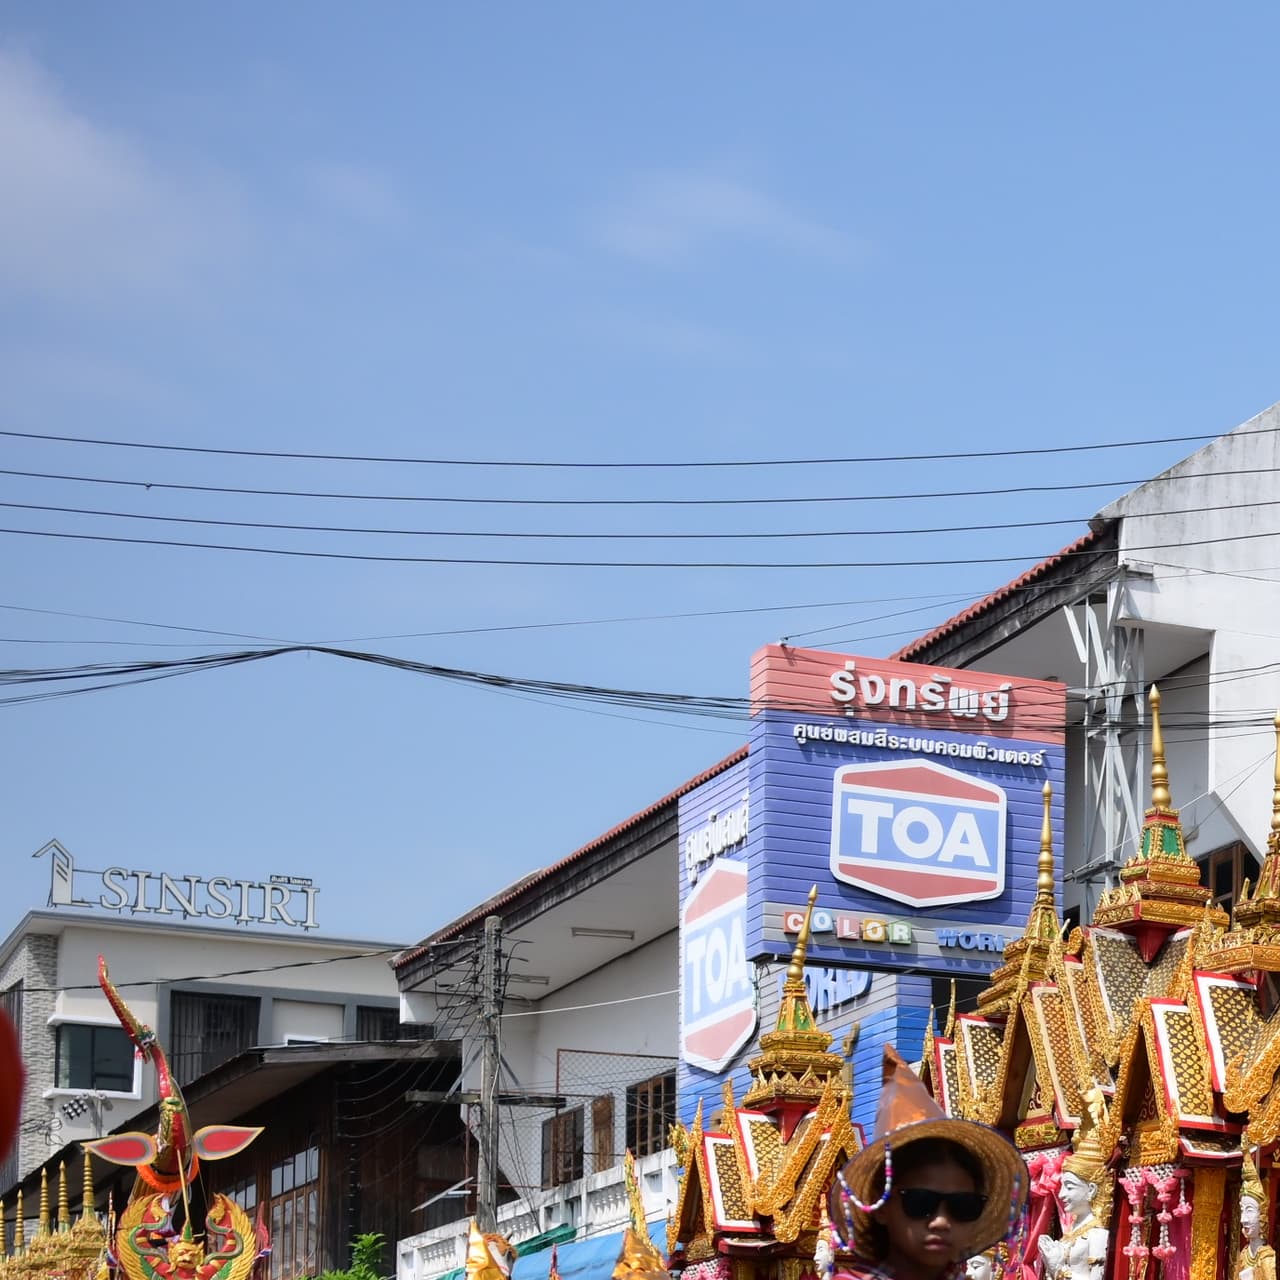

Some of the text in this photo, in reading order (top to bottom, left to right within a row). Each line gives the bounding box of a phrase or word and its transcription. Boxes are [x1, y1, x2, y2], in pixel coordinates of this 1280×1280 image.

[829, 660, 1014, 722] รุ่งทรัพย์
[846, 798, 991, 868] TOA
[99, 866, 322, 929] SINSIRI
[786, 910, 910, 943] COLOR
[686, 915, 750, 1015] TOA
